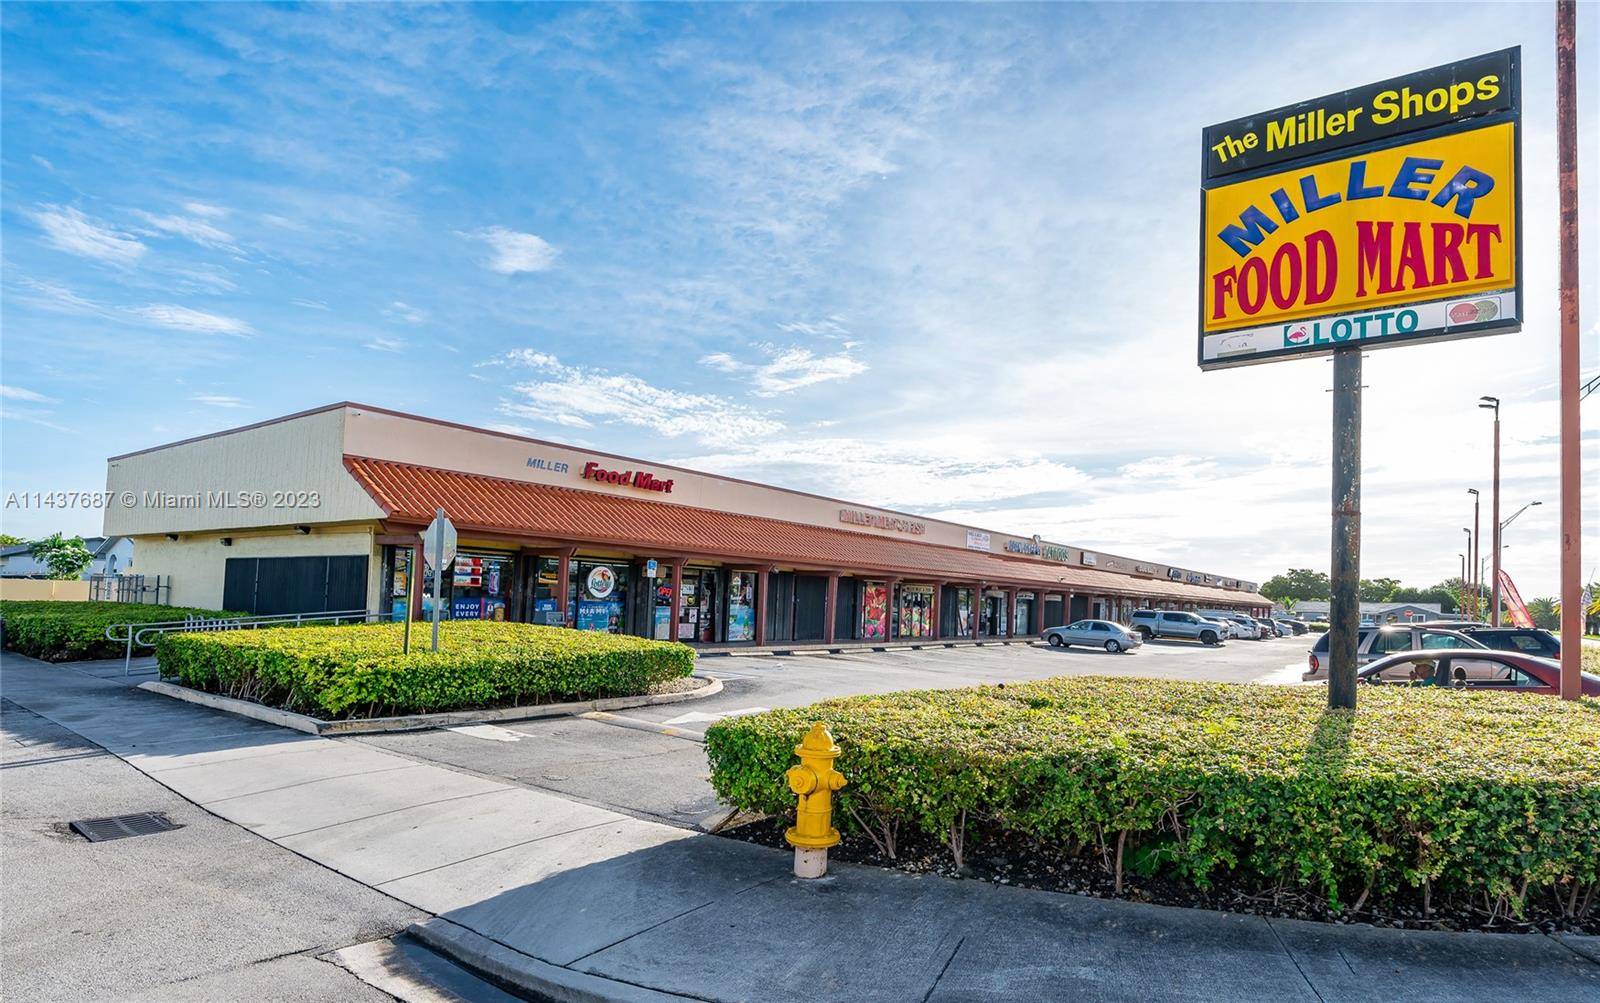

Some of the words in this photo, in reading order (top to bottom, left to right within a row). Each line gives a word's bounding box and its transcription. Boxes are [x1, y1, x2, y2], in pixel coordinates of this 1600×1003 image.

[1212, 132, 1259, 163] The
[1265, 105, 1363, 152] Miller
[1371, 74, 1500, 125] Shops
[1217, 157, 1495, 258] MILLER
[1212, 229, 1338, 320] FOOD
[1356, 221, 1502, 298] MART
[1313, 309, 1419, 344] LOTTO
[527, 458, 569, 474] MILLER
[582, 462, 632, 485] Food
[634, 471, 674, 493] Mart
